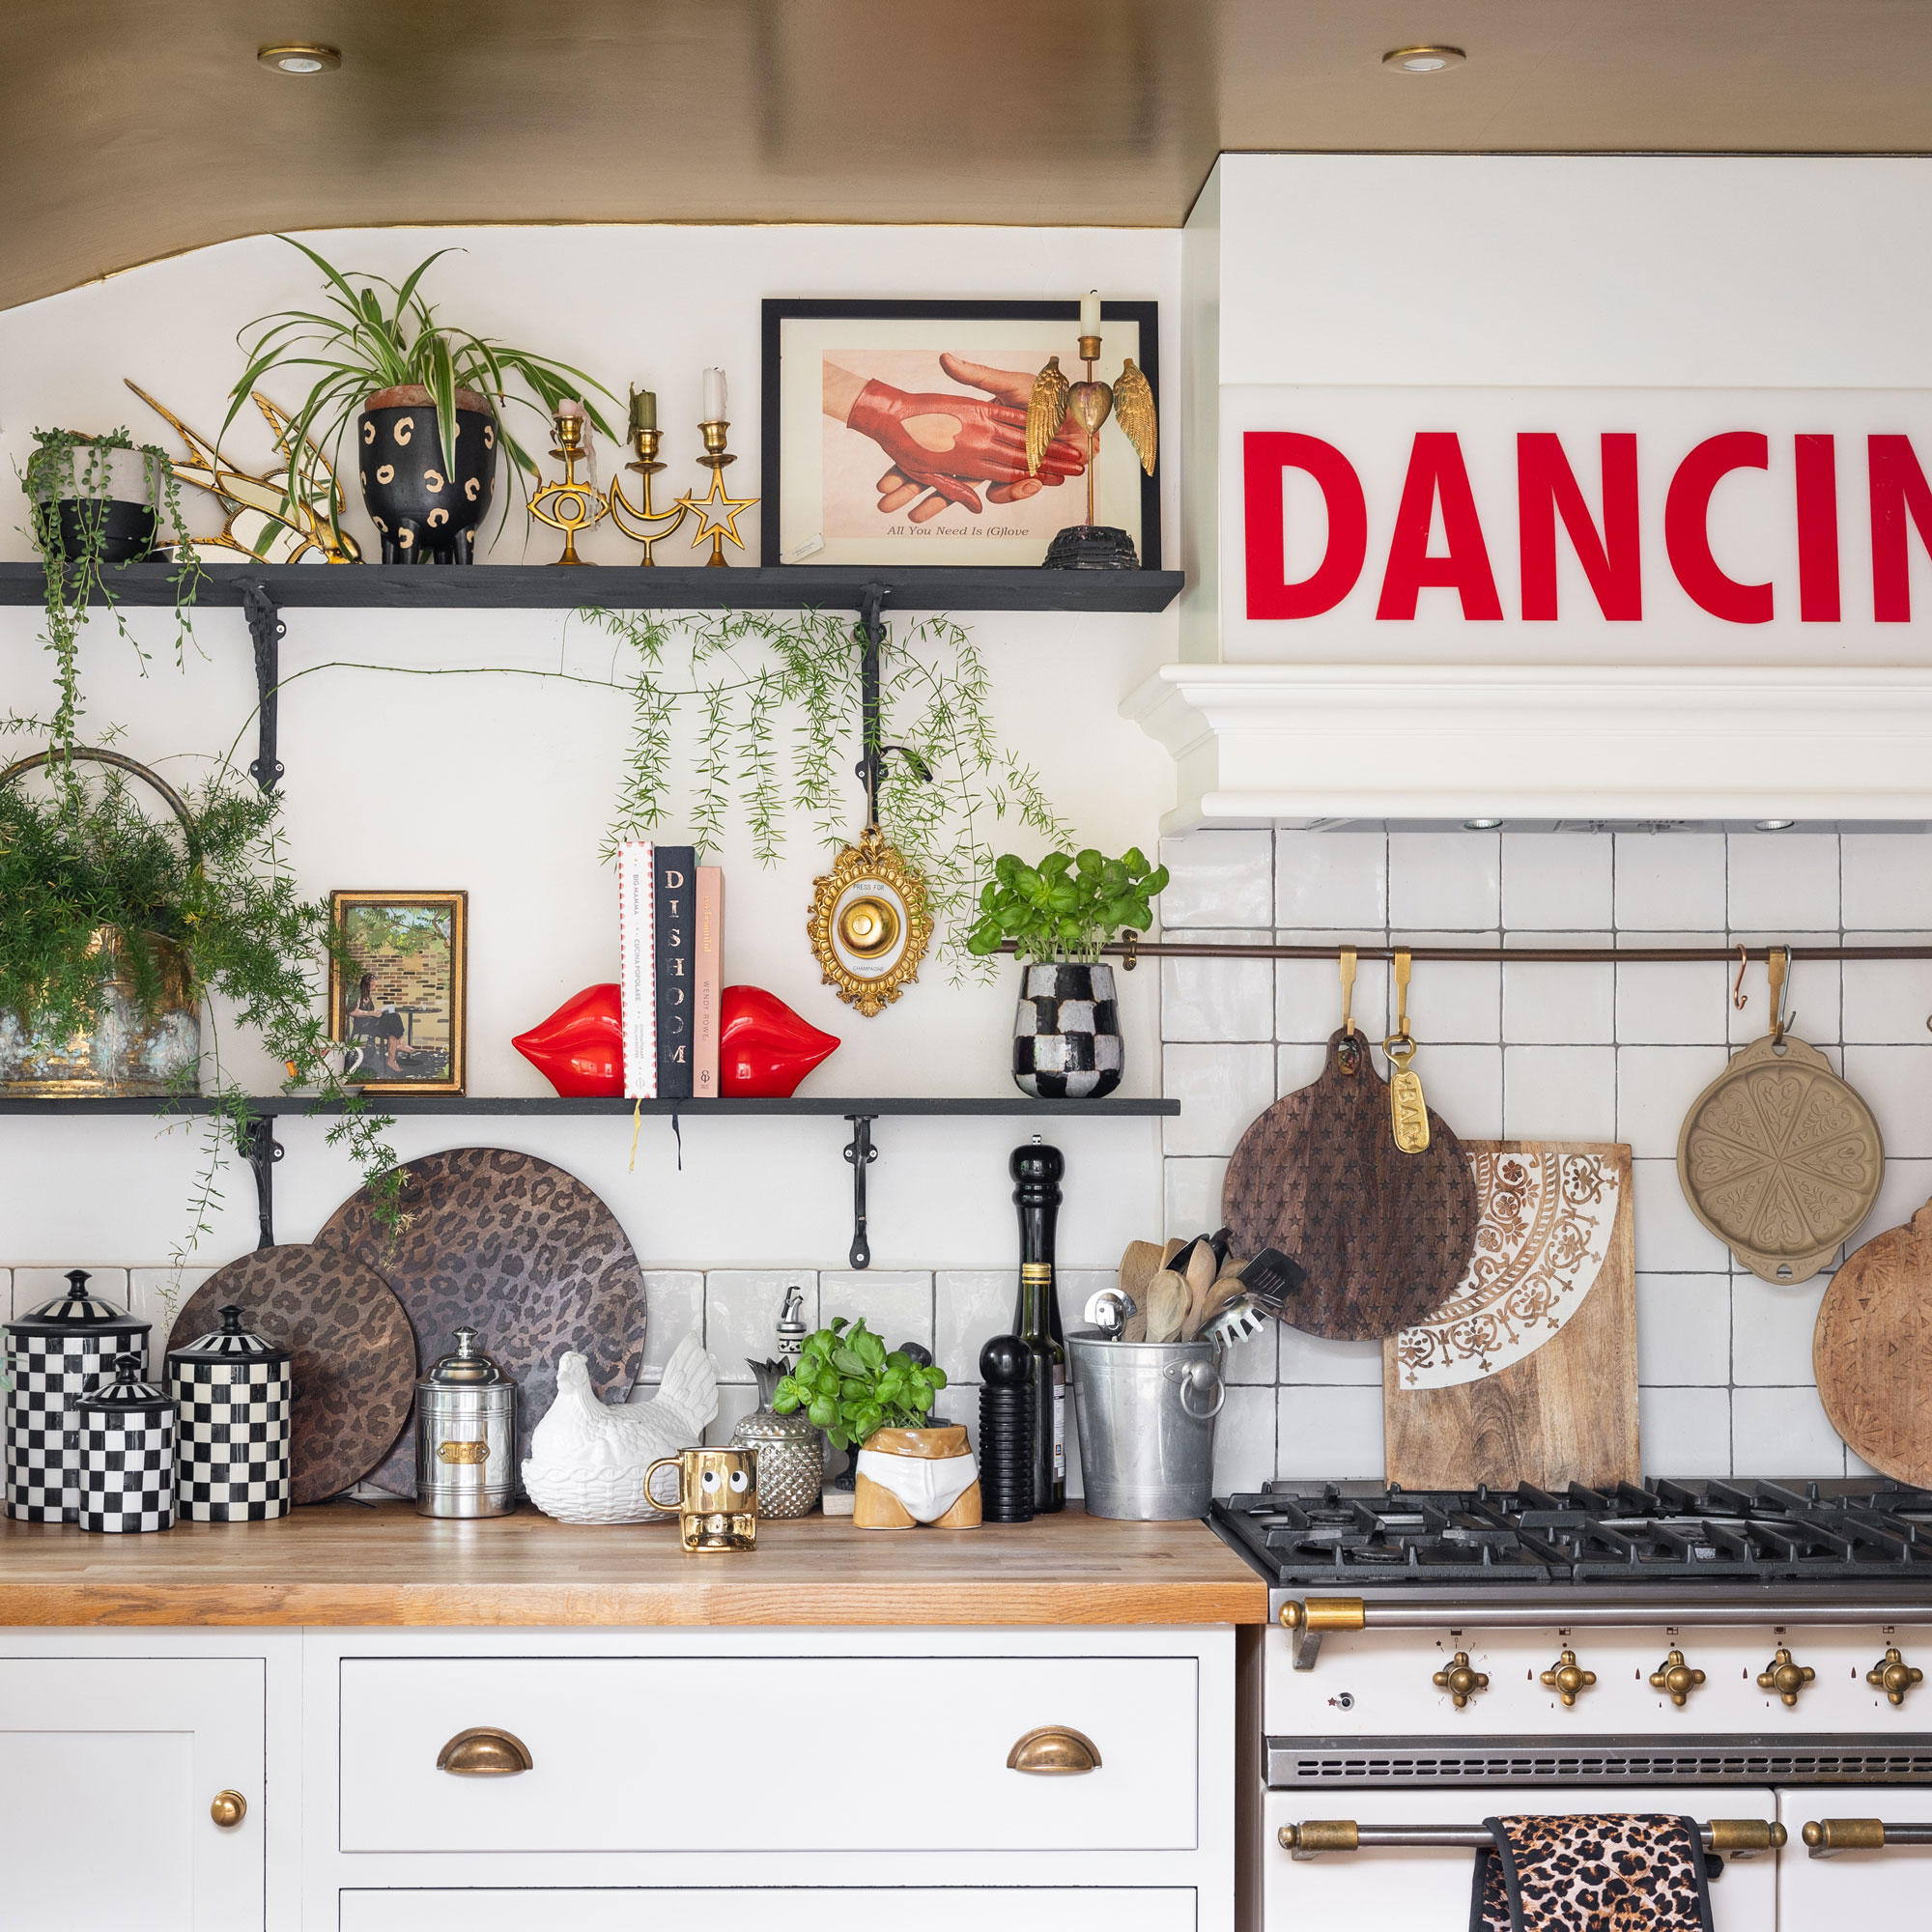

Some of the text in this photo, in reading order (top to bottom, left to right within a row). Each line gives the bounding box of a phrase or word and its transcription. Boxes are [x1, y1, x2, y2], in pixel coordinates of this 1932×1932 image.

[887, 526, 1029, 537] All You Need Is (G)love
[1398, 1088, 1422, 1137] BAR
